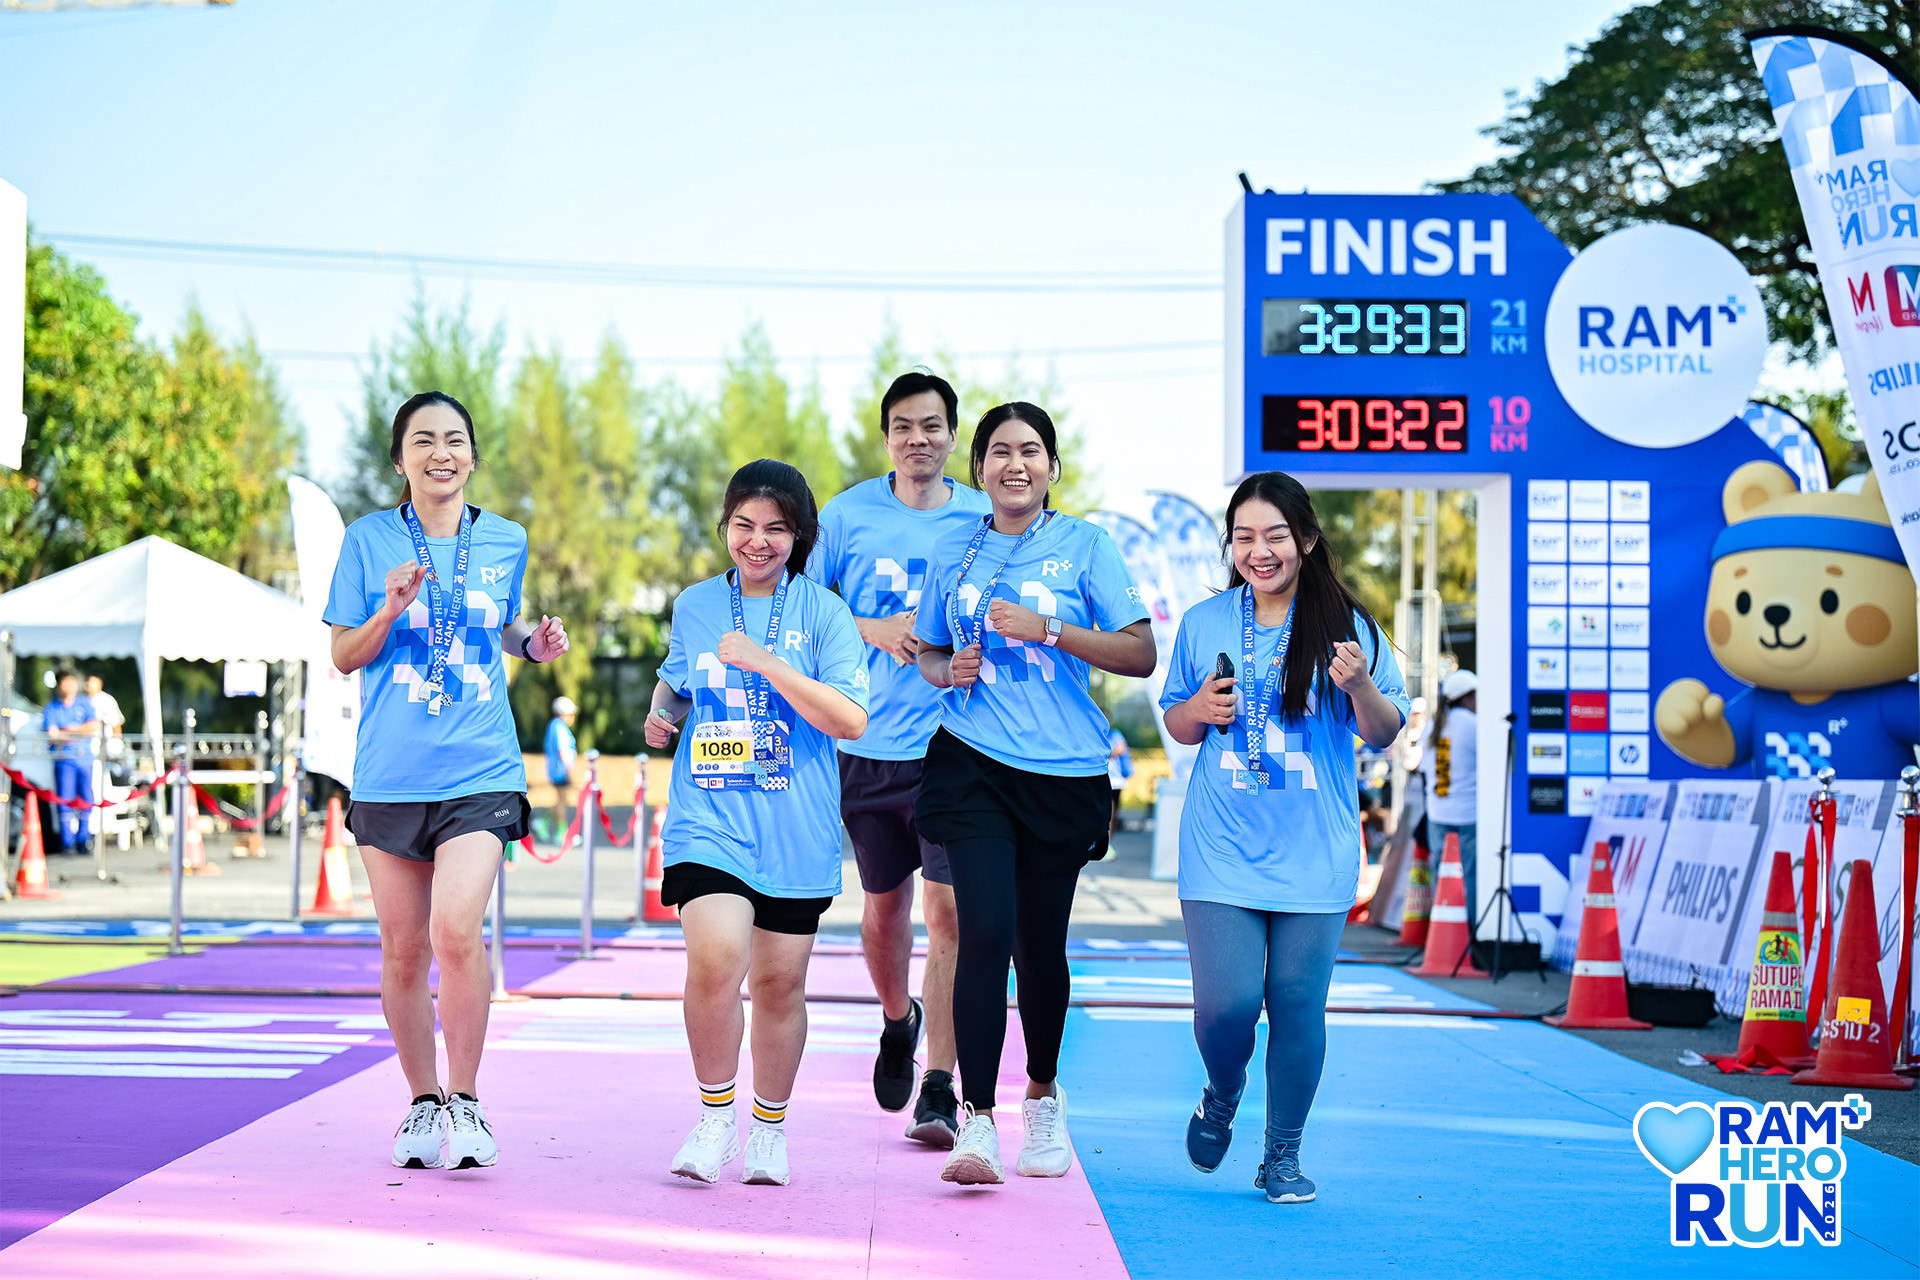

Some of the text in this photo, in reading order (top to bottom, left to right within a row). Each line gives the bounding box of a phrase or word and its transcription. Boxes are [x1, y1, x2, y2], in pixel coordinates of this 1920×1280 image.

[1265, 218, 1507, 277] FINISH
[1491, 300, 1527, 328] 21
[1579, 305, 1712, 348] RAM
[1299, 304, 1466, 355] 3:29:33
[1491, 333, 1528, 355] KM
[1579, 354, 1713, 375] HOSPITAL
[1488, 396, 1530, 425] 10
[1297, 399, 1465, 451] 3:09:22
[1491, 430, 1529, 452] KM
[409, 520, 424, 545] 2026
[460, 522, 471, 547] 2026
[417, 546, 433, 568] RUN
[457, 548, 469, 571] RUN
[962, 547, 978, 570] RUN
[431, 585, 443, 615] HERO
[449, 588, 464, 619] HERO
[731, 588, 741, 614] 2026
[974, 590, 992, 618] HERO
[768, 589, 786, 639] RUN 2026
[434, 618, 444, 645] RAM
[1244, 598, 1257, 726] RAM HERO RUN 2026
[1262, 670, 1277, 701] HERO
[1276, 630, 1292, 653] RUN
[747, 689, 757, 715] RAM
[757, 691, 769, 717] RAM
[700, 742, 744, 756] 1080
[774, 735, 782, 746] 3
[494, 808, 510, 819] RUN
[1661, 860, 1738, 924] PHILIPS
[1751, 989, 1792, 1009] RAMA
[1867, 1022, 1881, 1044] 2
